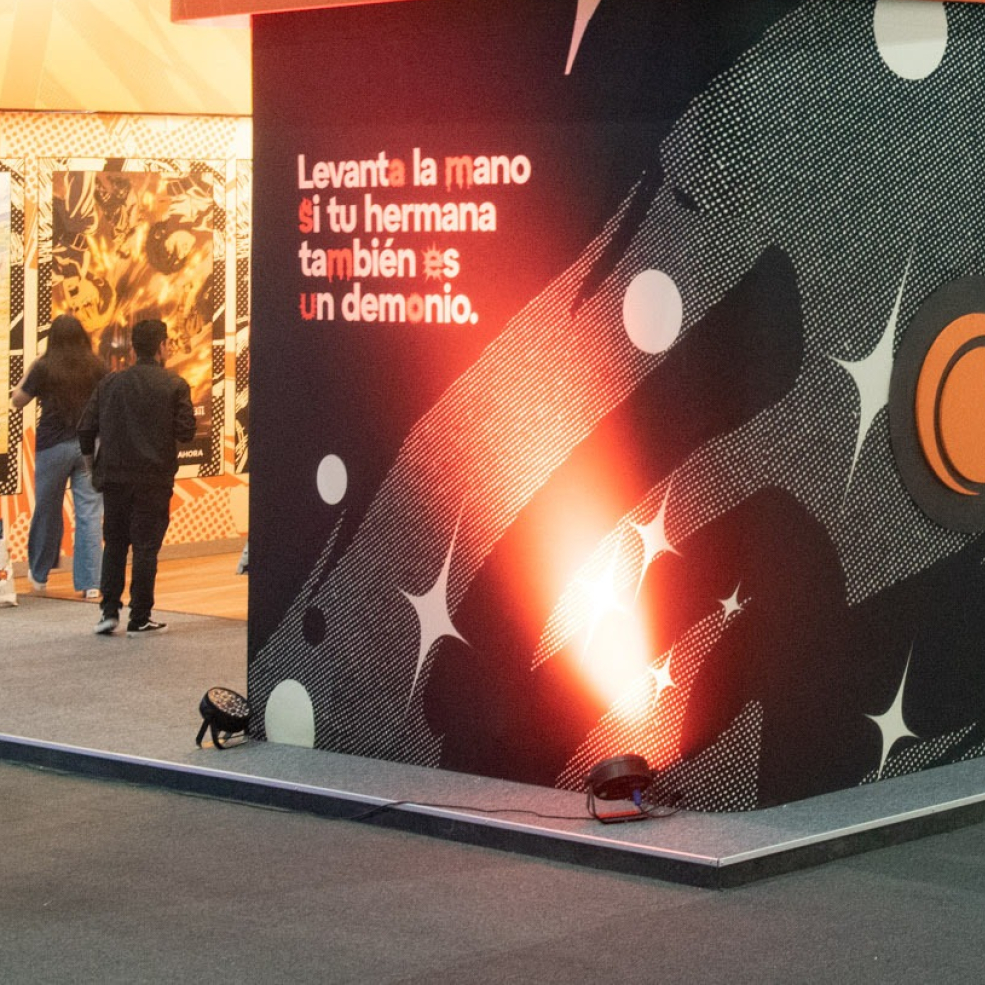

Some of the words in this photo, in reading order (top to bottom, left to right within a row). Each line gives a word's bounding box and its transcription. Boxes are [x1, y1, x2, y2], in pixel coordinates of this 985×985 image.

[297, 150, 406, 189] Levanta
[413, 147, 438, 186] la
[444, 154, 532, 192] mano
[298, 193, 321, 233] si
[327, 196, 357, 233] tu
[364, 193, 497, 232] hermana
[298, 237, 417, 282] también
[422, 242, 460, 281] es
[300, 292, 334, 320] un
[341, 282, 479, 325] demonio.
